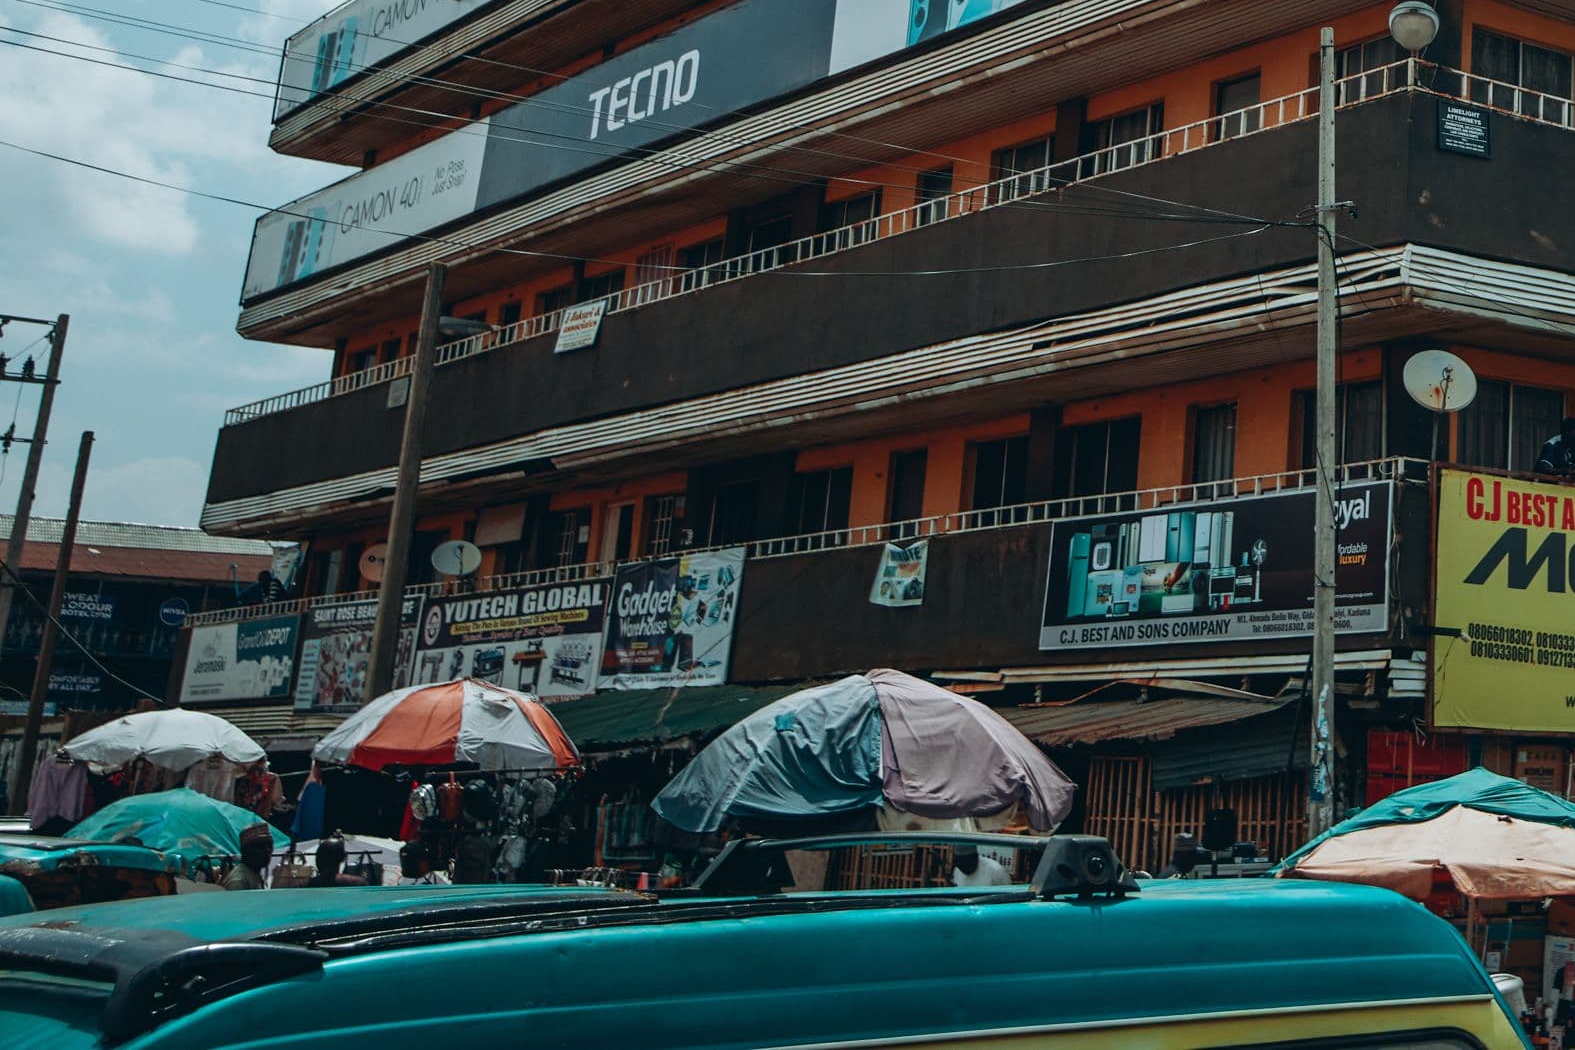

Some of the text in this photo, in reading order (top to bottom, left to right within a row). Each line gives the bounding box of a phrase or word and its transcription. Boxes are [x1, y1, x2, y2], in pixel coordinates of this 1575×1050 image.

[589, 50, 700, 140] TECNO
[1448, 107, 1480, 118] LIMELIGHT
[341, 177, 418, 234] CAMON 40
[1466, 477, 1502, 522] C.J
[1507, 490, 1558, 528] BEST
[1339, 553, 1367, 566] luxury
[163, 607, 186, 615] NIVEA
[445, 594, 519, 624] YUTECH
[522, 583, 603, 614] GLOBAL
[618, 580, 676, 622] Gadget
[314, 607, 356, 622] SAINT ROSE
[620, 615, 668, 637] Warehouse
[1060, 619, 1231, 644] C.J. BEST AND SONS COMPANY
